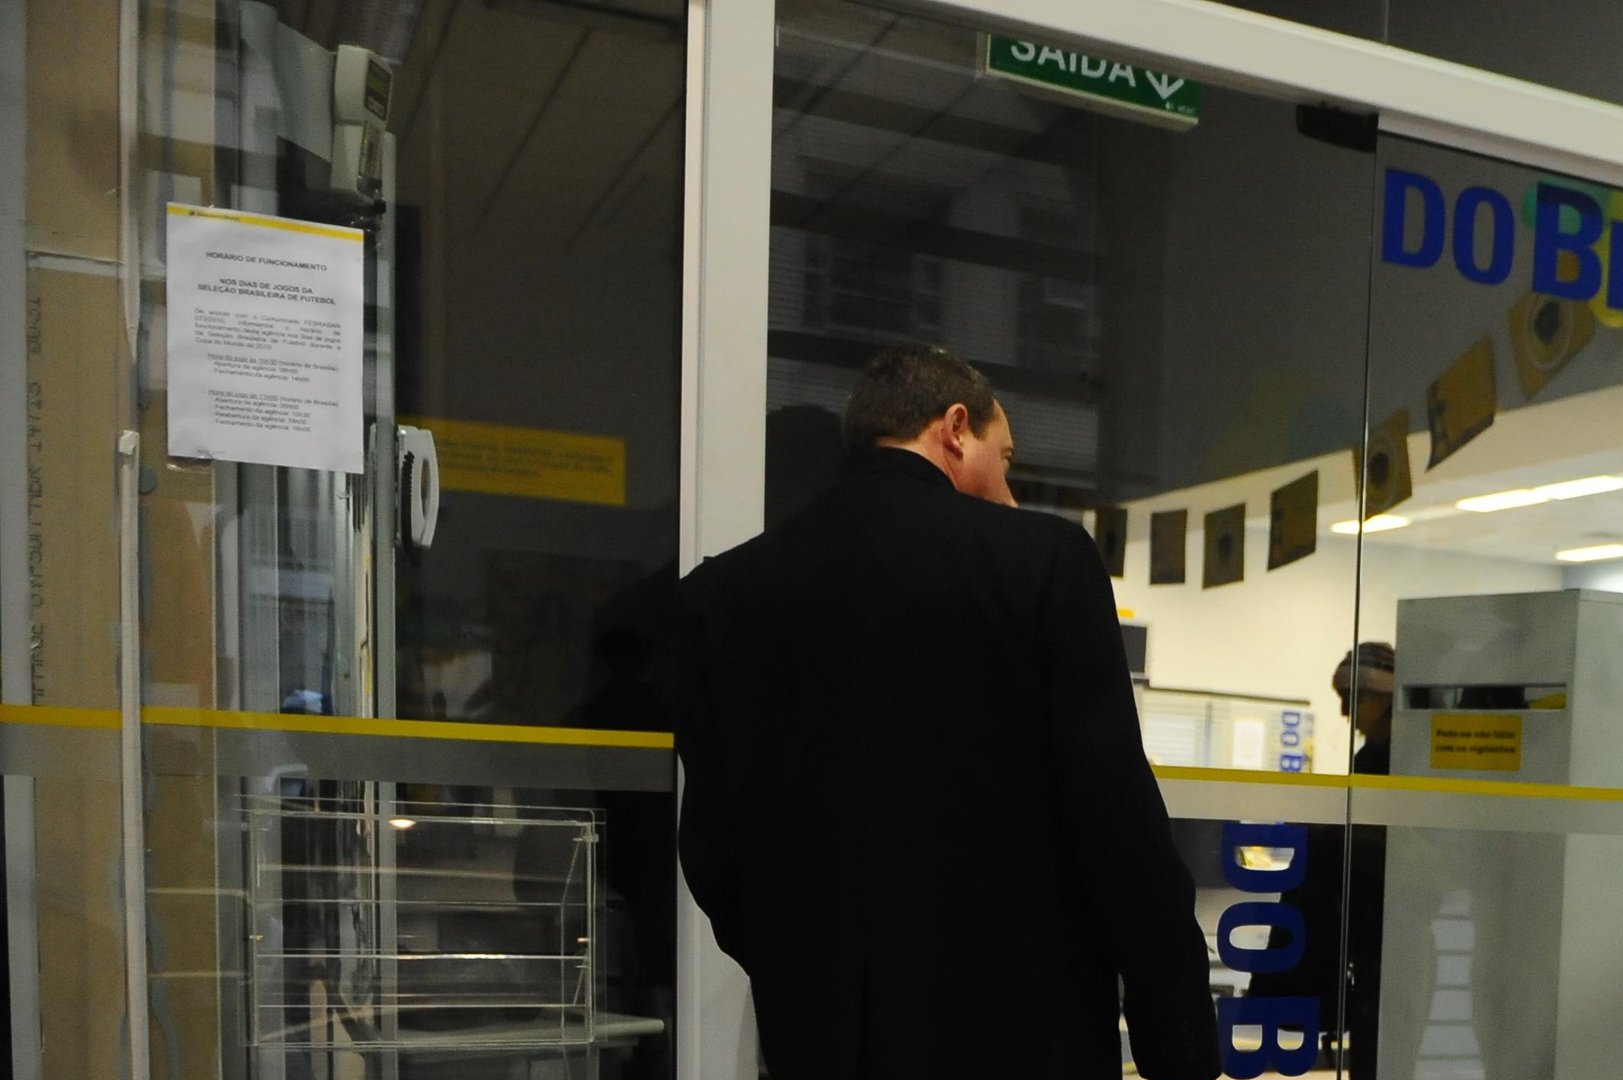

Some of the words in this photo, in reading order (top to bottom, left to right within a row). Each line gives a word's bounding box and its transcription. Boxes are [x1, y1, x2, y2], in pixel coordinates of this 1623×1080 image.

[1381, 166, 1515, 286] DO
[206, 251, 245, 263] HORÁRIO
[258, 257, 328, 272] FUNCIONAMENTO
[198, 283, 237, 296] SELEÇÃO
[238, 287, 286, 300] BRASILEIRA
[300, 295, 337, 306] FUTEBOL
[273, 284, 301, 294] JOGOS
[1216, 821, 1308, 974] DO
